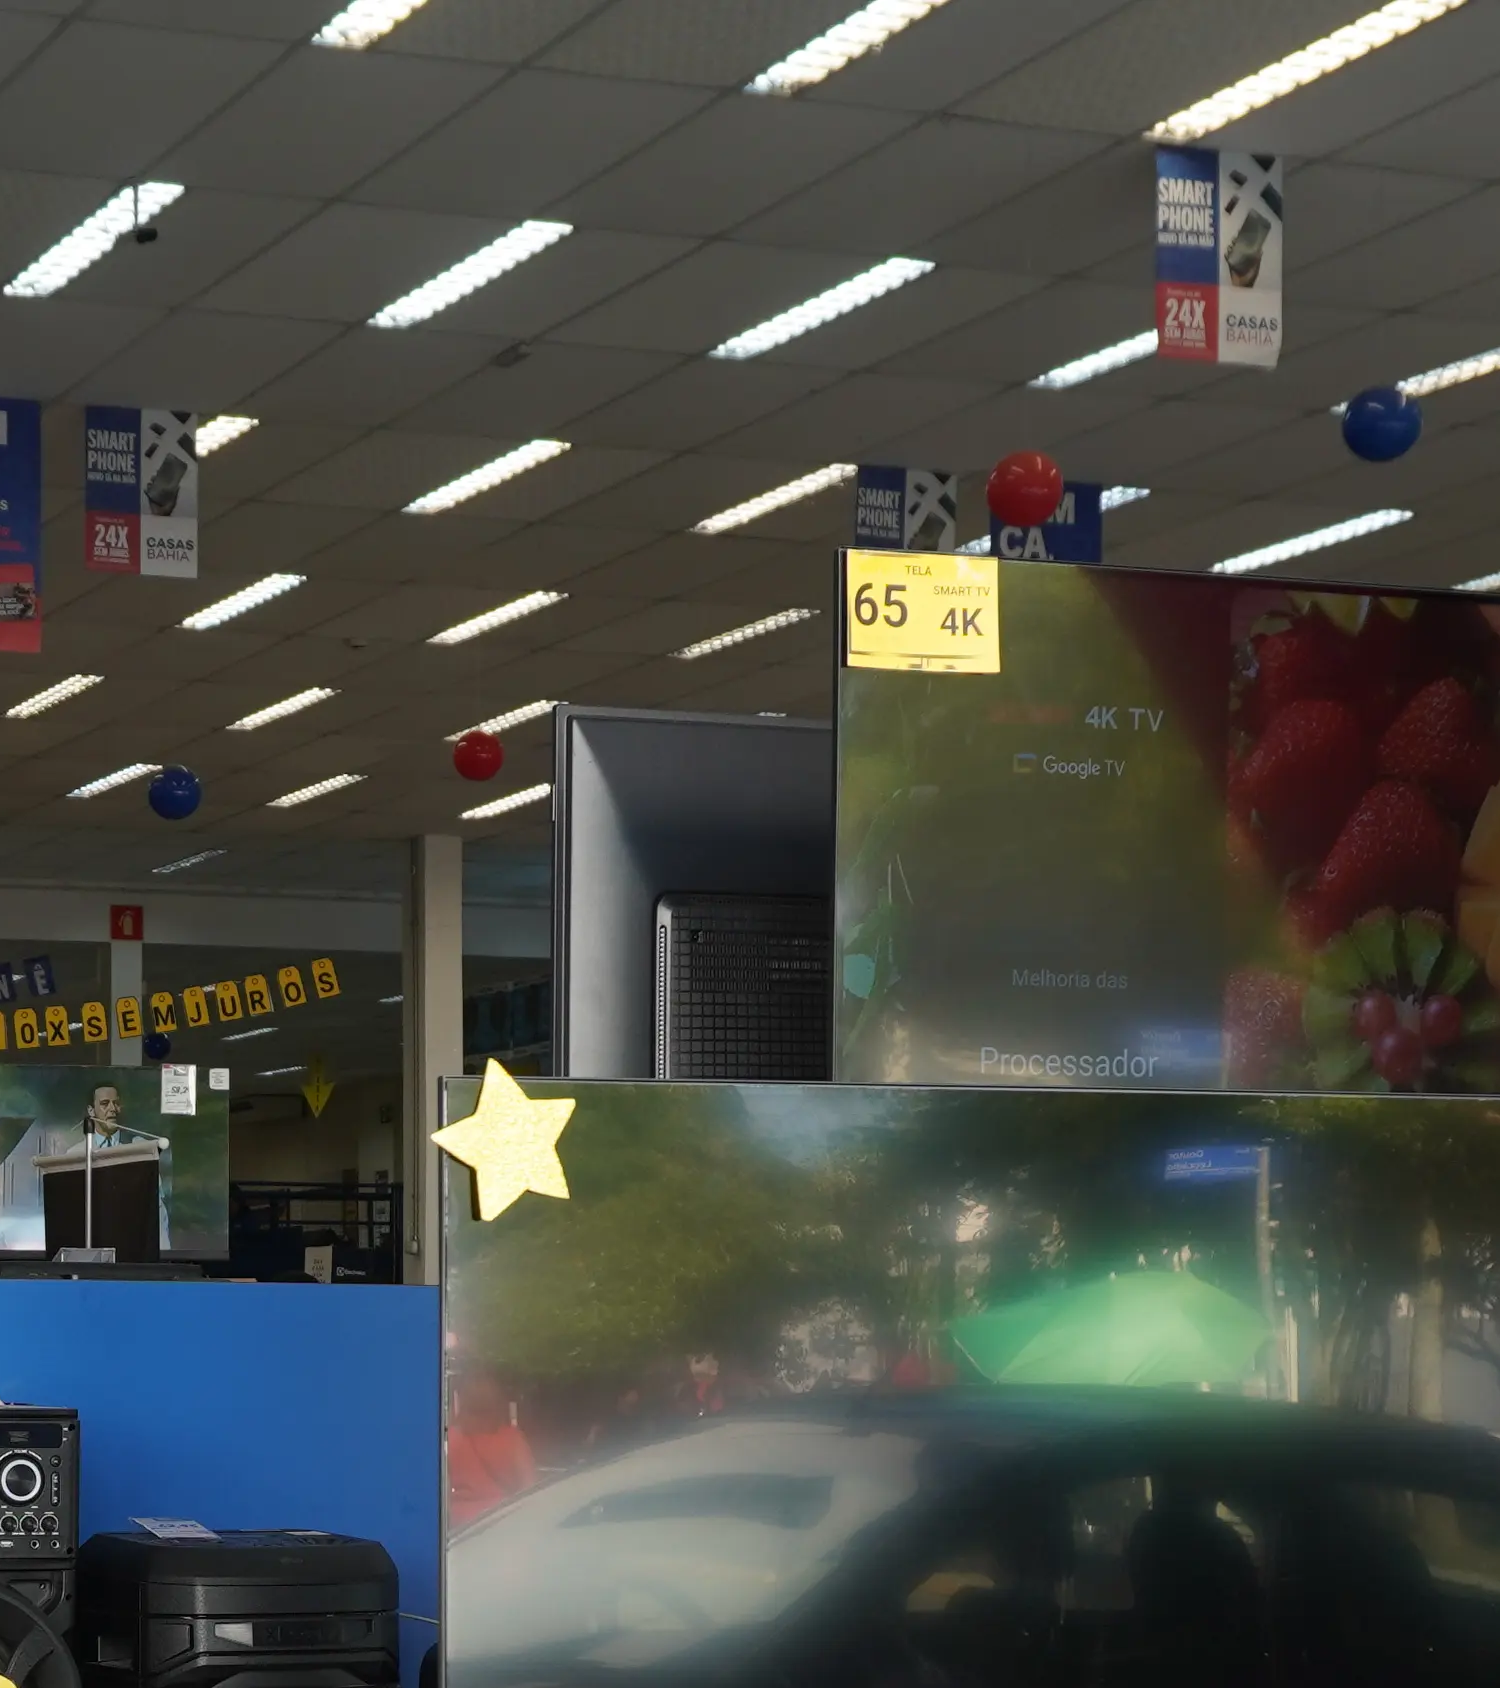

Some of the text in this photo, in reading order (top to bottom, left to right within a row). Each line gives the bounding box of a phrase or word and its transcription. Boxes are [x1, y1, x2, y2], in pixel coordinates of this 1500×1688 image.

[1158, 177, 1214, 206] SMART
[1157, 204, 1214, 231] PHONE
[1165, 298, 1205, 327] 24X
[1225, 313, 1278, 331] CASAS
[1225, 328, 1274, 346] BAHIA
[905, 565, 932, 576] TELA
[853, 583, 990, 628] 65 SMART TV
[940, 607, 983, 637] 4K
[1084, 705, 1164, 732] 4K TV
[1042, 755, 1126, 780] Google TV
[979, 1045, 1159, 1080] Processador
